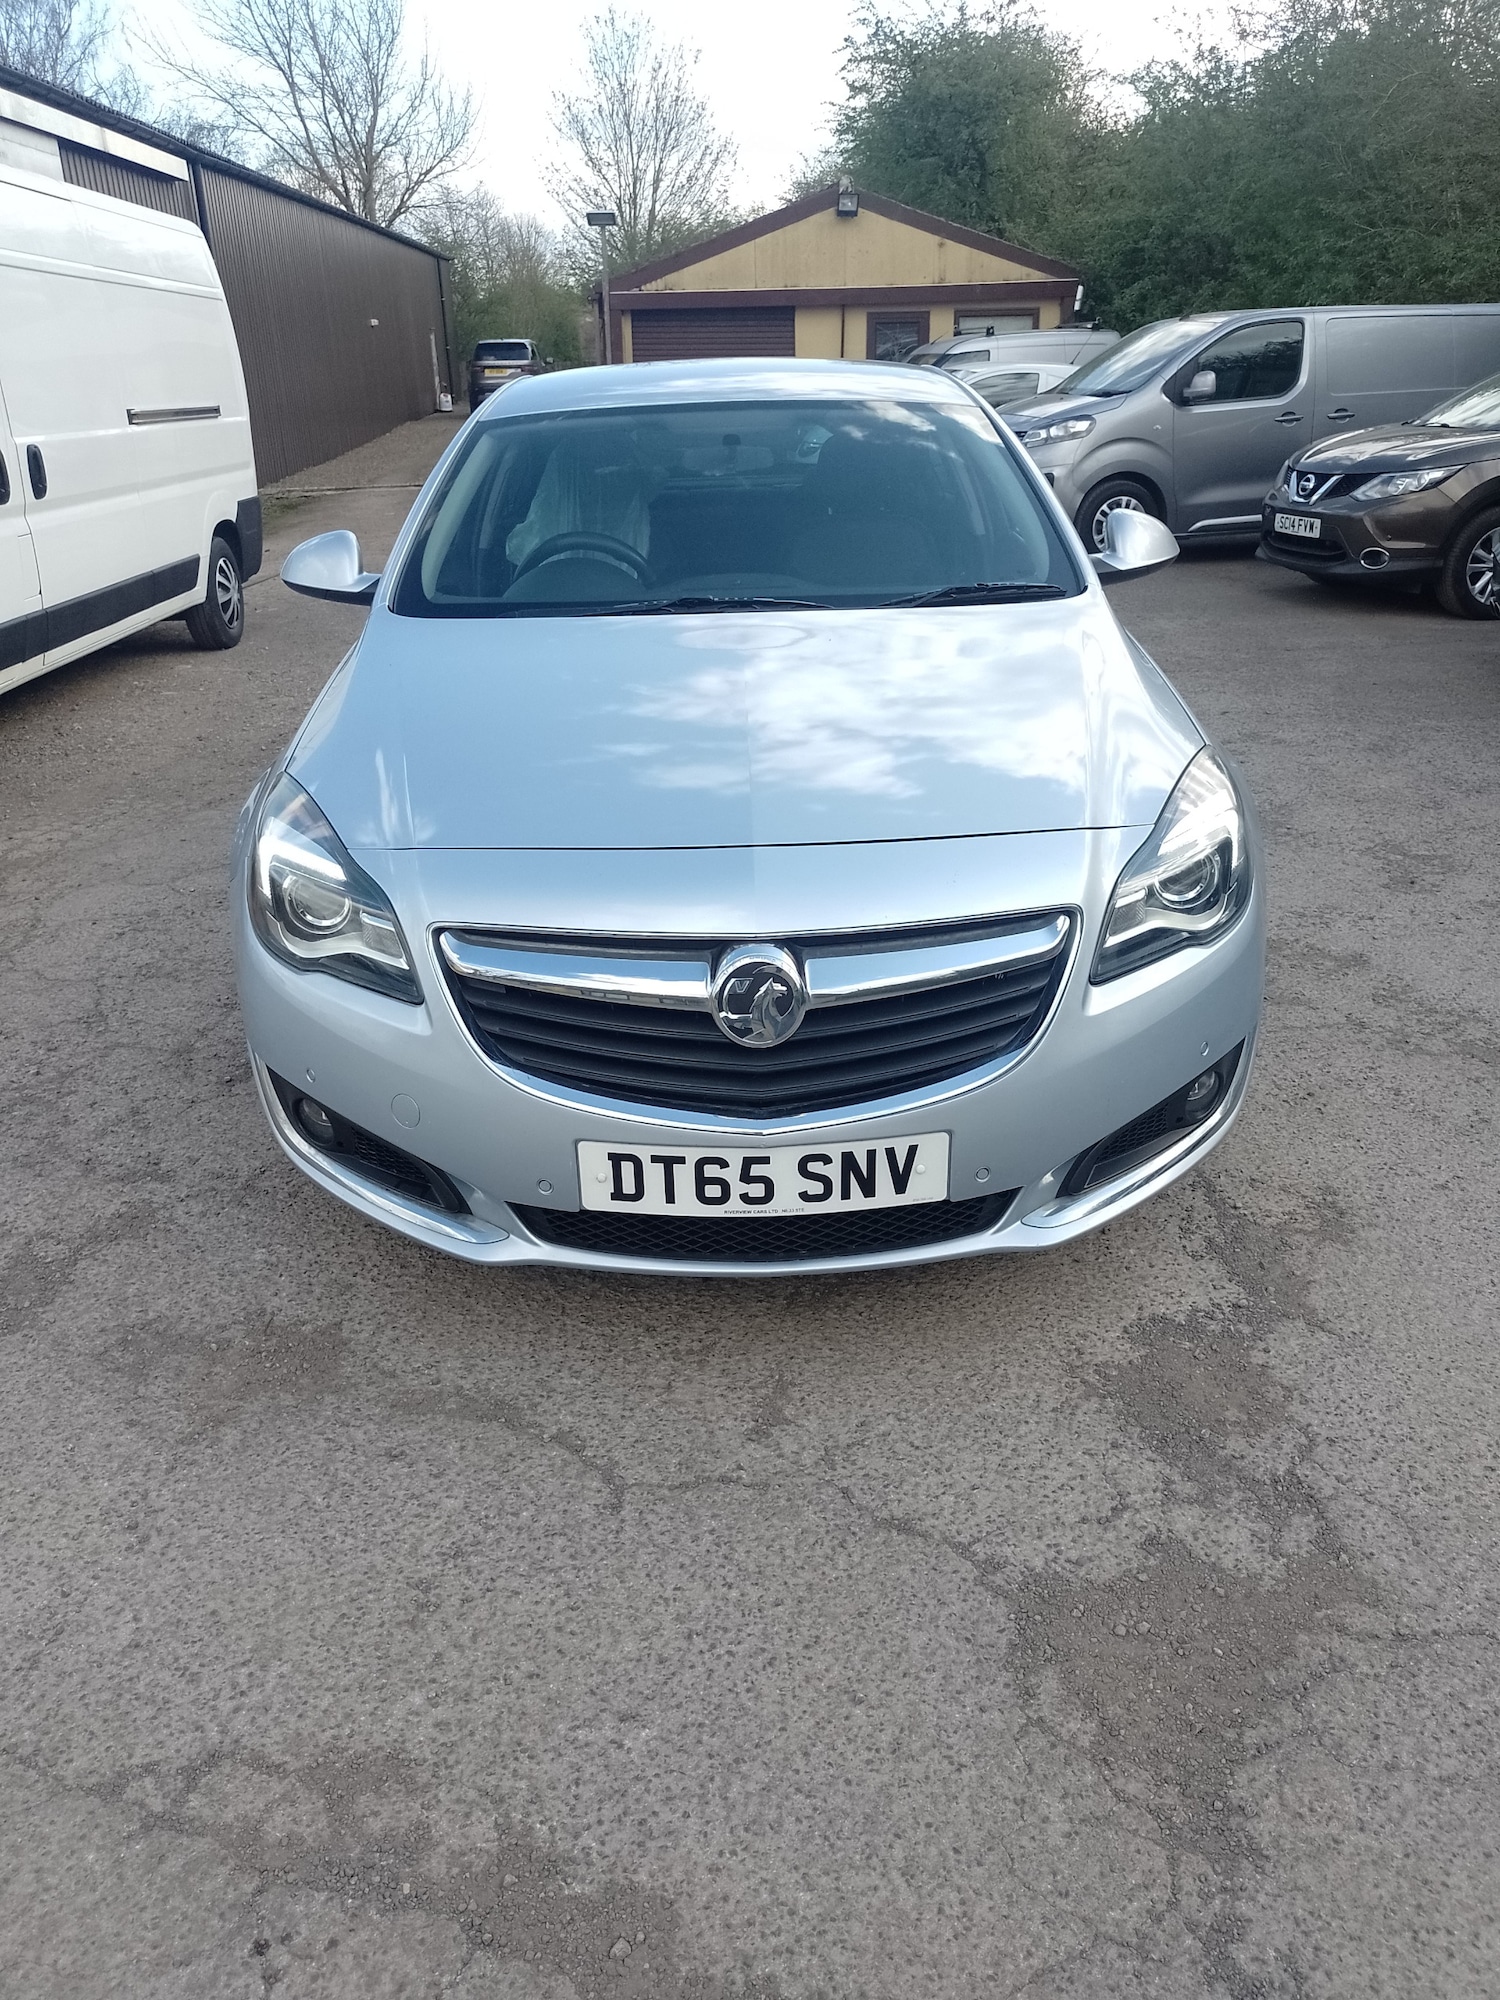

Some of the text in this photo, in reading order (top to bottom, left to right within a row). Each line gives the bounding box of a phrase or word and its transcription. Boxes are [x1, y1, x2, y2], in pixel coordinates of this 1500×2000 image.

[1279, 516, 1316, 534] SC14 FVW
[607, 1144, 918, 1206] DT65 SNV
